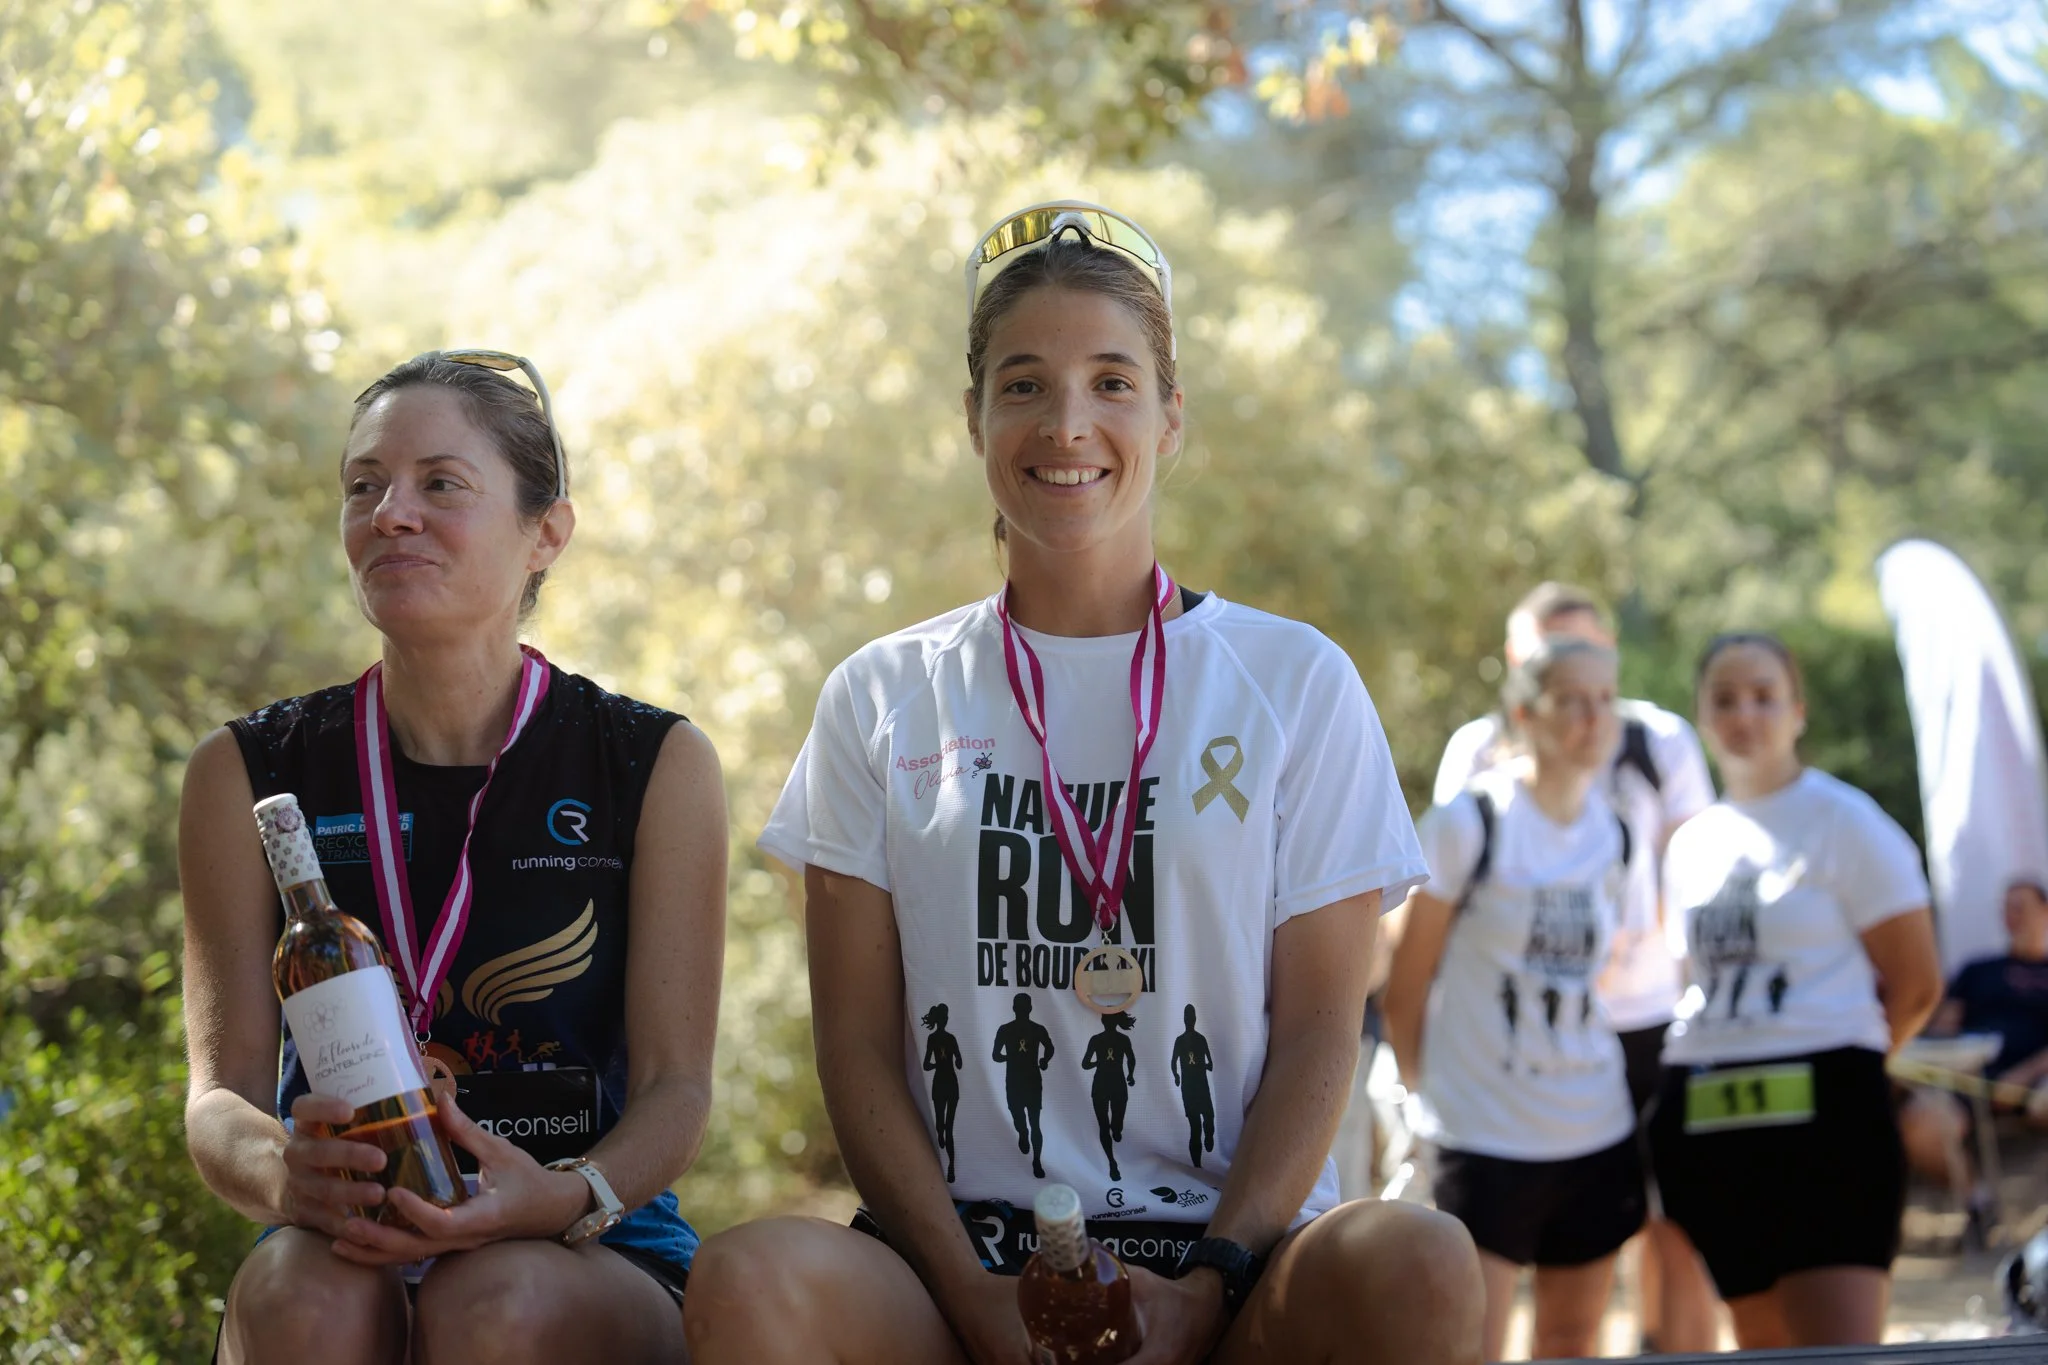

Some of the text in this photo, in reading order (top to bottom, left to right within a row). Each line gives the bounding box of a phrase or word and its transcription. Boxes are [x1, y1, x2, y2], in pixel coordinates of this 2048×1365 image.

[317, 824, 356, 835] PATRIC
[977, 942, 1009, 986] DE
[1721, 1079, 1767, 1115] 11
[1178, 1193, 1209, 1208] Smith
[1179, 1189, 1195, 1200] DS
